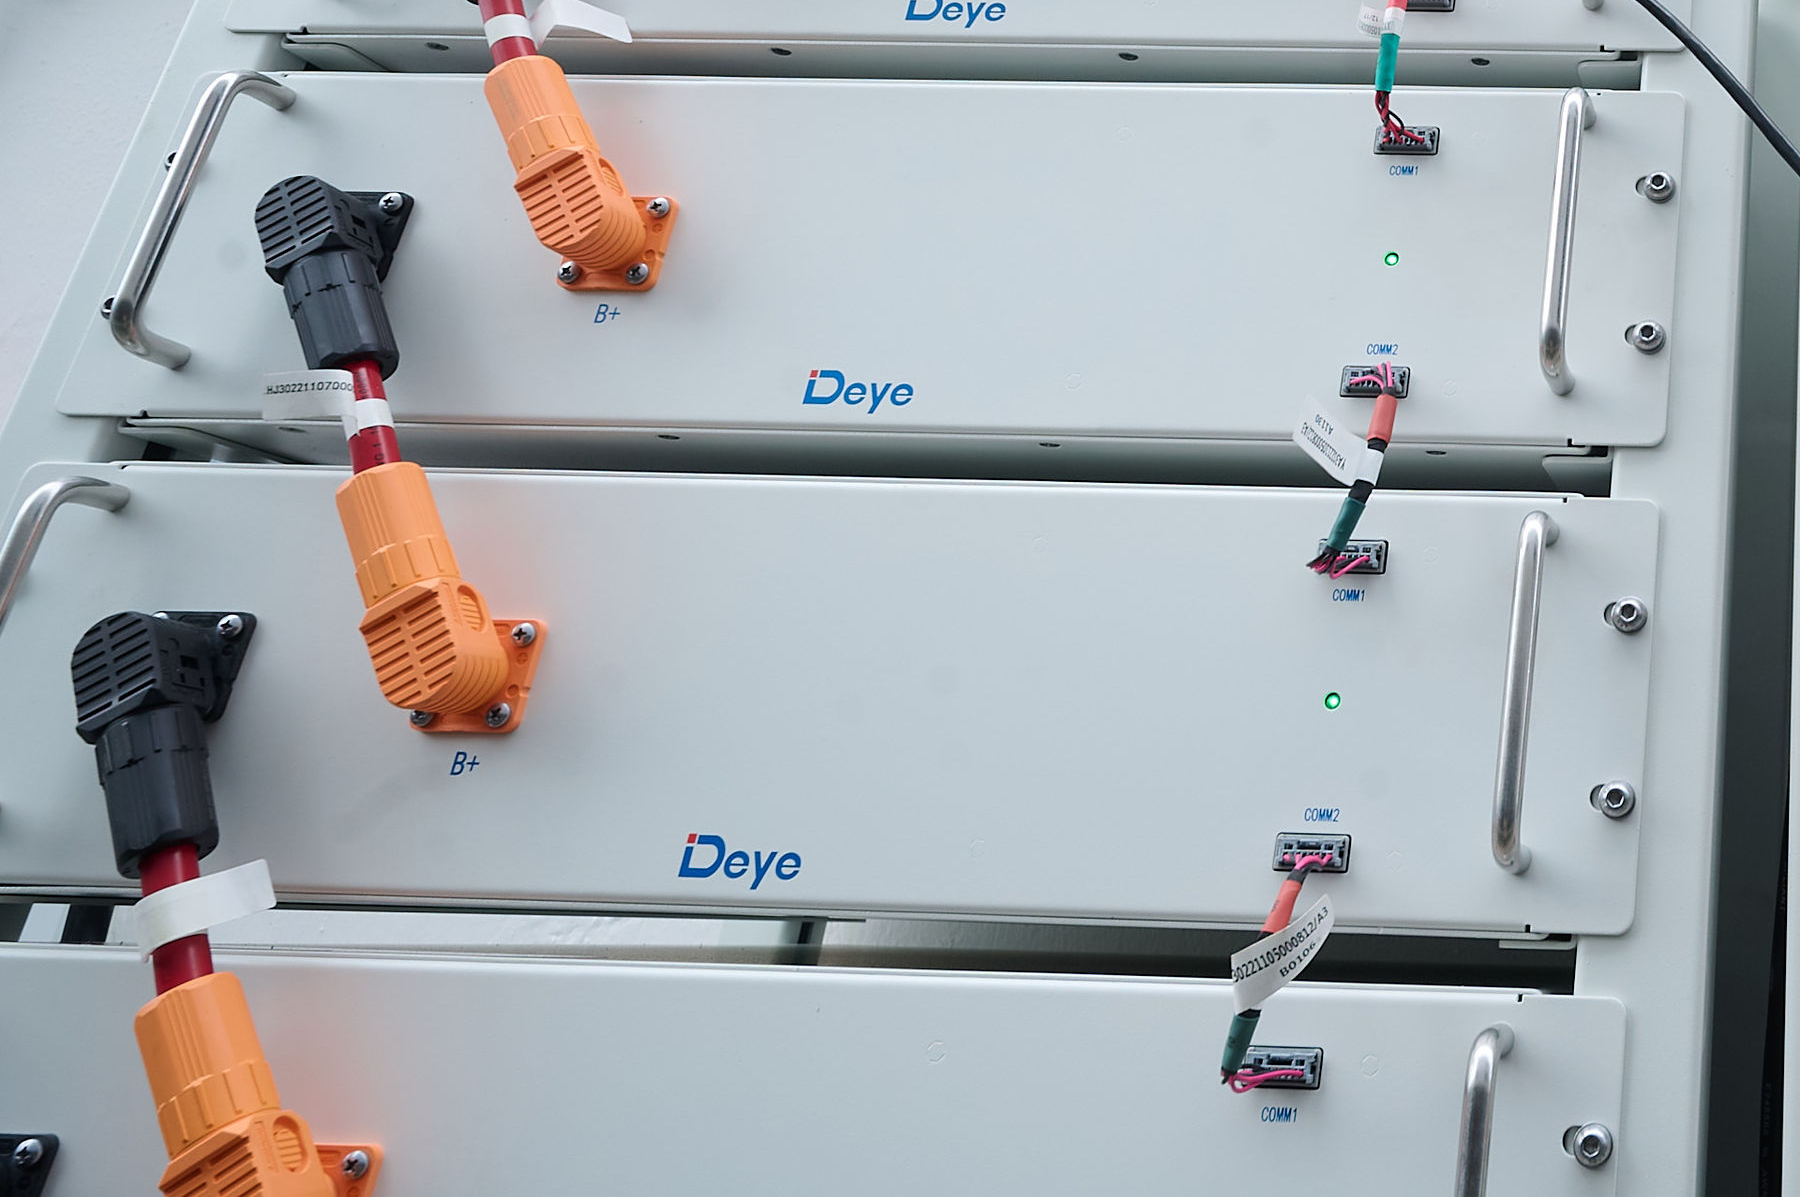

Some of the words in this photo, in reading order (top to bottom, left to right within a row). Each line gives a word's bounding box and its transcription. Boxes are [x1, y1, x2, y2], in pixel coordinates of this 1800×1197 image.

[1388, 164, 1419, 176] COMM1
[593, 303, 622, 324] B+
[1366, 342, 1399, 356] COMM2
[802, 369, 915, 415] Deye
[1332, 588, 1366, 603] COMM1
[449, 750, 481, 778] B+
[1304, 807, 1340, 824] COMM2
[677, 832, 802, 891] Deye
[1260, 1105, 1298, 1124] COMM1
